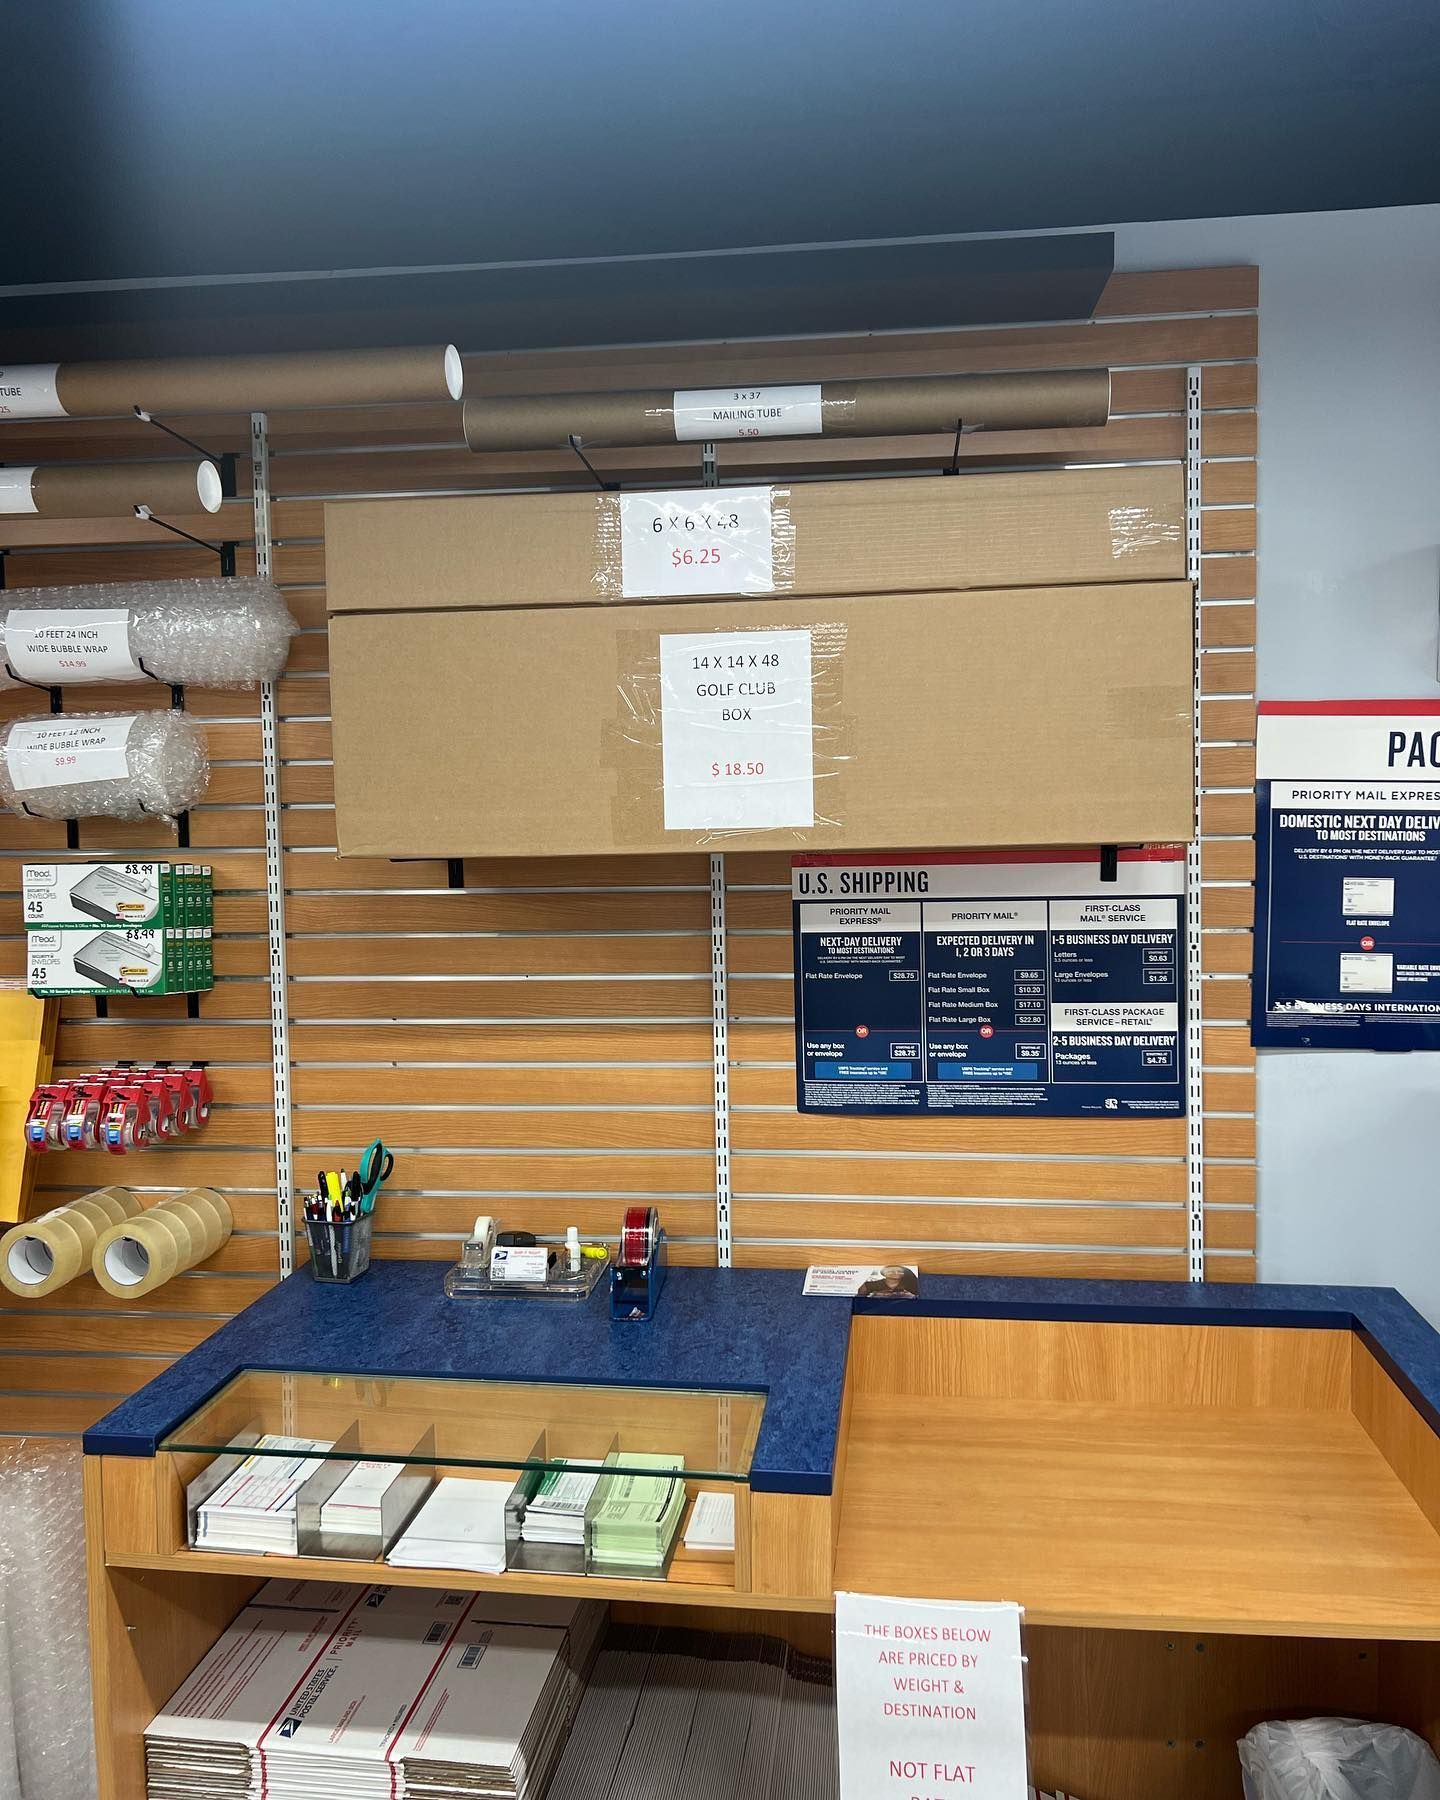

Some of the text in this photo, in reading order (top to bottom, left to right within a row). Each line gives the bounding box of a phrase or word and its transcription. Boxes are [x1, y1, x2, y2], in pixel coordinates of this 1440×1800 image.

[733, 392, 739, 401] 3
[749, 391, 761, 400] 37
[712, 408, 782, 421] MAILING TUBE
[738, 428, 760, 437] 5.50
[652, 513, 740, 533] 6 X 6 X 48
[671, 548, 721, 567] $6.25
[46, 630, 64, 638] FEET
[66, 630, 76, 639] 24
[78, 630, 98, 639] INCH
[27, 645, 108, 654] WIDE BUBBLE WRAP
[59, 660, 87, 668] $14.99
[692, 654, 780, 670] 14 X 14 X 48
[696, 682, 776, 697] GOLF CLUB
[721, 708, 752, 721] BOX
[49, 740, 79, 750] BUBBLE
[81, 737, 106, 746] WRAP
[55, 756, 77, 766] $9.99
[725, 762, 764, 776] 18.50
[1292, 790, 1351, 800] PRIORITY
[1355, 791, 1387, 800] MAIL
[1279, 814, 1342, 828] DOMESTIC
[1344, 815, 1376, 829] NEXT
[1378, 815, 1403, 829] DAY
[1316, 829, 1426, 842] TO MOST DESTINATIONS
[125, 864, 153, 875] $8.99
[798, 870, 929, 895] U.S. SHIPPING
[27, 901, 43, 913] 45
[1084, 904, 1141, 912] FIRST-CLASS
[951, 912, 991, 920] PRIORITY
[1107, 914, 1146, 922] SERVICE
[126, 929, 155, 941] $8.99
[936, 935, 1034, 946] EXPECTED DELIVERY IN
[1066, 934, 1110, 945] BUSINESS
[1111, 934, 1129, 945] DAY
[1131, 933, 1173, 944] DELIVERY
[820, 936, 902, 947] NEXT-DAY DELIVERY
[853, 946, 895, 954] DESTINATIONS
[963, 947, 969, 957] 2
[970, 947, 983, 957] OR
[984, 947, 990, 957] 3
[991, 947, 1014, 957] DAYS
[32, 967, 47, 979] 45
[834, 972, 863, 981] Envelope
[957, 972, 987, 980] Envelope
[1054, 971, 1109, 979] Large Envelopes
[1018, 986, 1041, 994] $10.20
[1019, 1001, 1041, 1009] $17.10
[1345, 1003, 1372, 1011] DAYS
[1064, 1008, 1165, 1016] FIRST-CLASS PACKAGE
[958, 1016, 977, 1024] Large
[1076, 1018, 1113, 1026] SERVICE
[1052, 1035, 1176, 1046] 2-5 BUSINESS DAY DELIVERY
[814, 1050, 843, 1058] envelope
[937, 1051, 967, 1059] envelope
[1055, 1052, 1091, 1061] Packages
[330, 1617, 358, 1655] PRIORITY
[345, 1629, 362, 1647] MAIL
[864, 1624, 991, 1642] THE BOXES BELOW
[878, 1651, 978, 1668] ARE PRICED BY
[893, 1677, 965, 1694] WEIGHT &
[289, 1688, 310, 1716] UNITED
[305, 1669, 325, 1691] STATES
[298, 1667, 337, 1718] POSTAL SERVICE
[883, 1702, 976, 1720] DESTINATION
[889, 1760, 976, 1783] NOT FLAT
